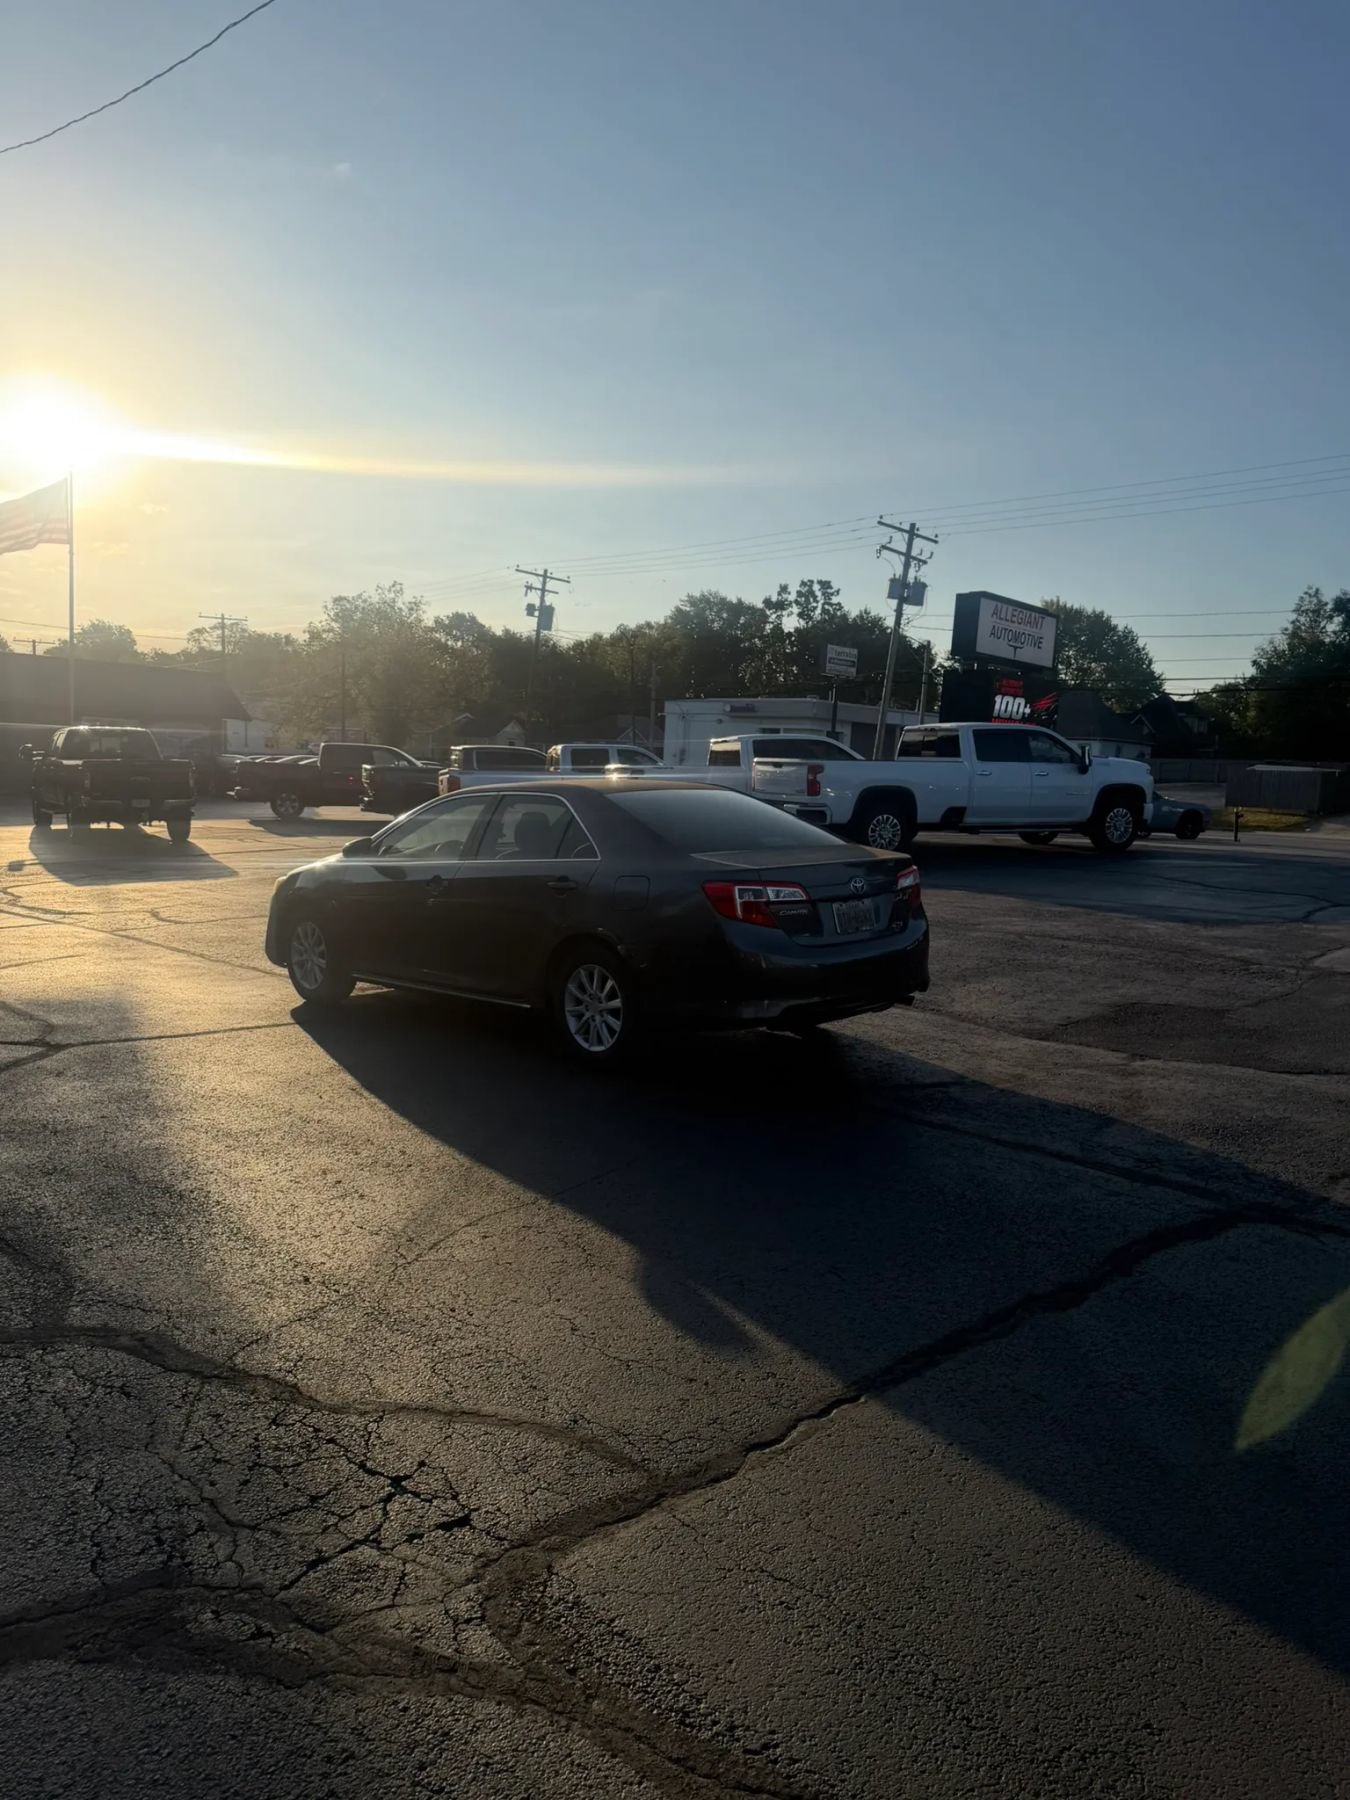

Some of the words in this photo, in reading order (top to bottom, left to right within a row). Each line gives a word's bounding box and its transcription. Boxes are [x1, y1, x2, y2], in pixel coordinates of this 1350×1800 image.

[991, 604, 1045, 630] ALLEGIANT
[989, 625, 1044, 649] AUTOMOTIVE
[992, 694, 1032, 720] 100+
